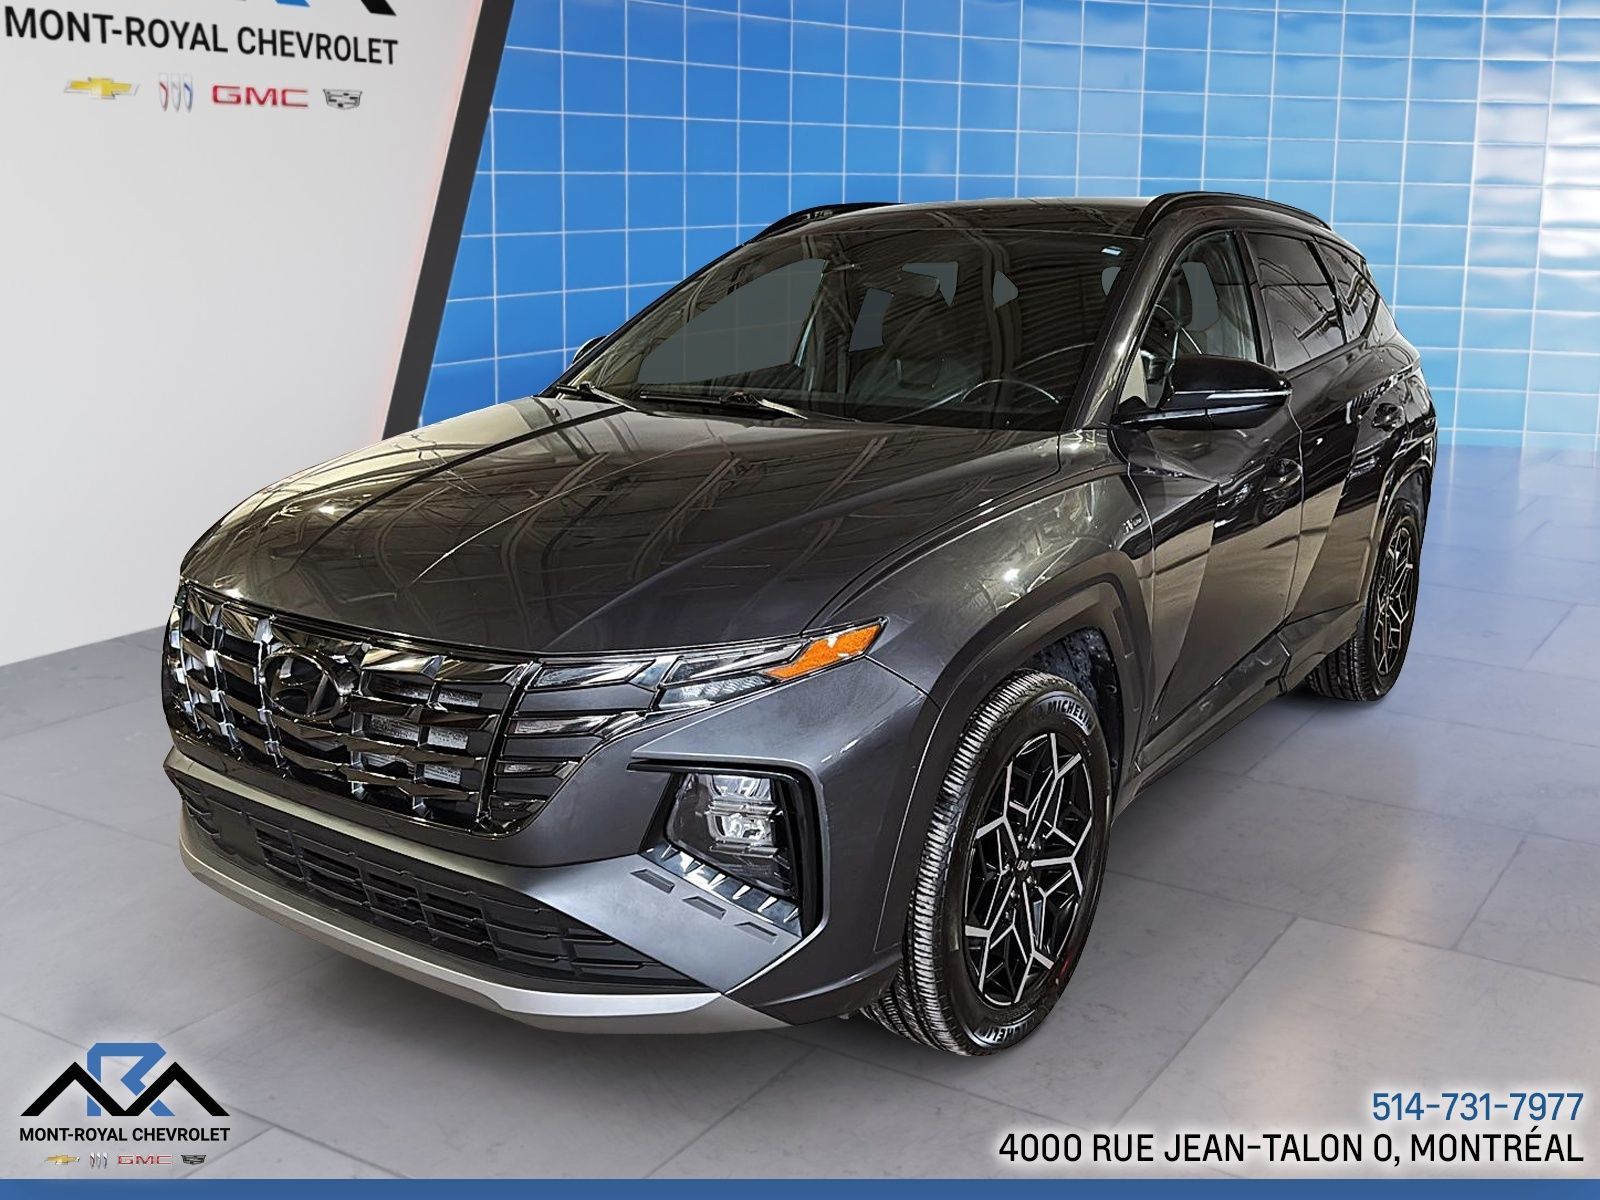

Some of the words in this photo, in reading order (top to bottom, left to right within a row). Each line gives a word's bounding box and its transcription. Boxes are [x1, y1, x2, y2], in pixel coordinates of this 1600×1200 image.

[4, 5, 229, 53] MONT-ROYAL
[237, 26, 399, 65] CHEVROLET
[211, 84, 309, 108] GMC
